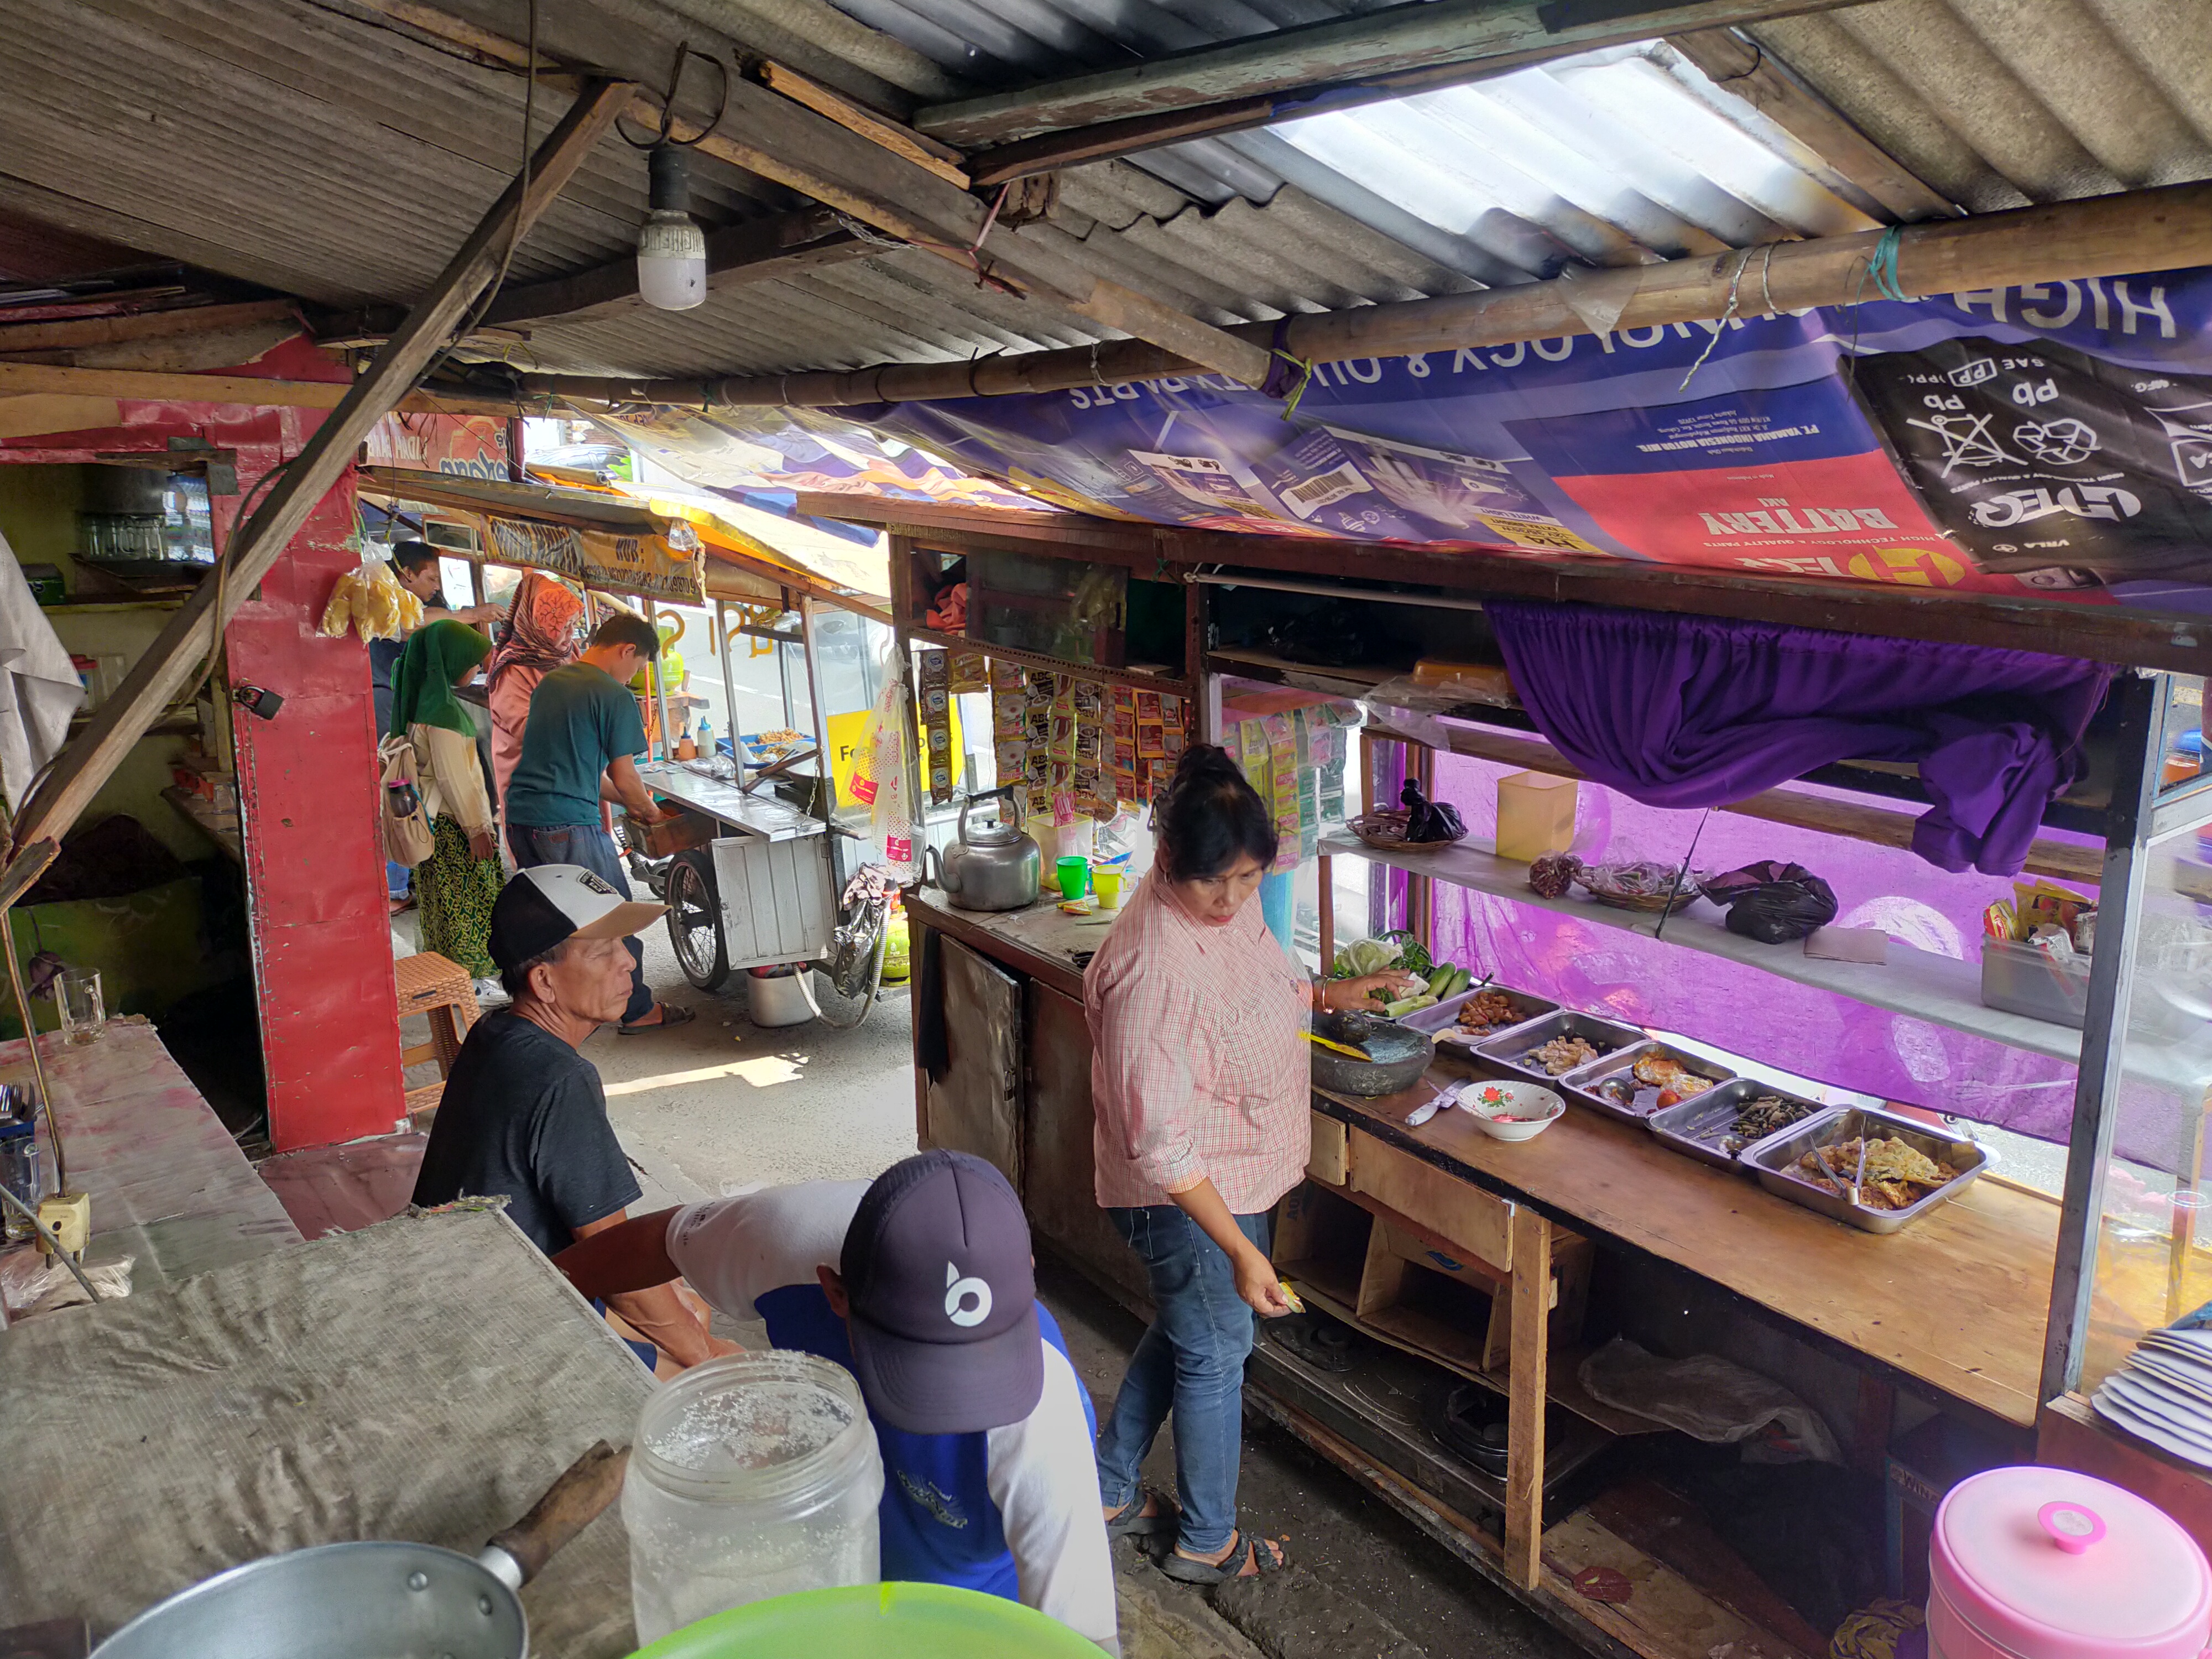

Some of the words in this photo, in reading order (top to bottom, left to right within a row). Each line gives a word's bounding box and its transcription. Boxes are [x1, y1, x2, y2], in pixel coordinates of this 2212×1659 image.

[1952, 278, 2176, 338] HIGH
[2002, 358, 2044, 369] SAE
[2012, 378, 2059, 407] Pb
[1923, 394, 1965, 410] Pb
[1755, 427, 1799, 442] YAMAHA
[1800, 424, 1820, 435] PT.
[1660, 439, 1697, 451] MOTOR
[1698, 434, 1754, 447] INDONESIA
[1479, 508, 1508, 519] LIGHT
[1508, 512, 1543, 522] WHITE
[1698, 508, 1898, 535] BATTERY
[1524, 535, 1580, 551] H4
[1744, 539, 1794, 547] QUALITY
[1810, 536, 1897, 545] TECHNOLOGY
[2024, 539, 2069, 549] VRLA
[1031, 671, 1053, 682] ABC
